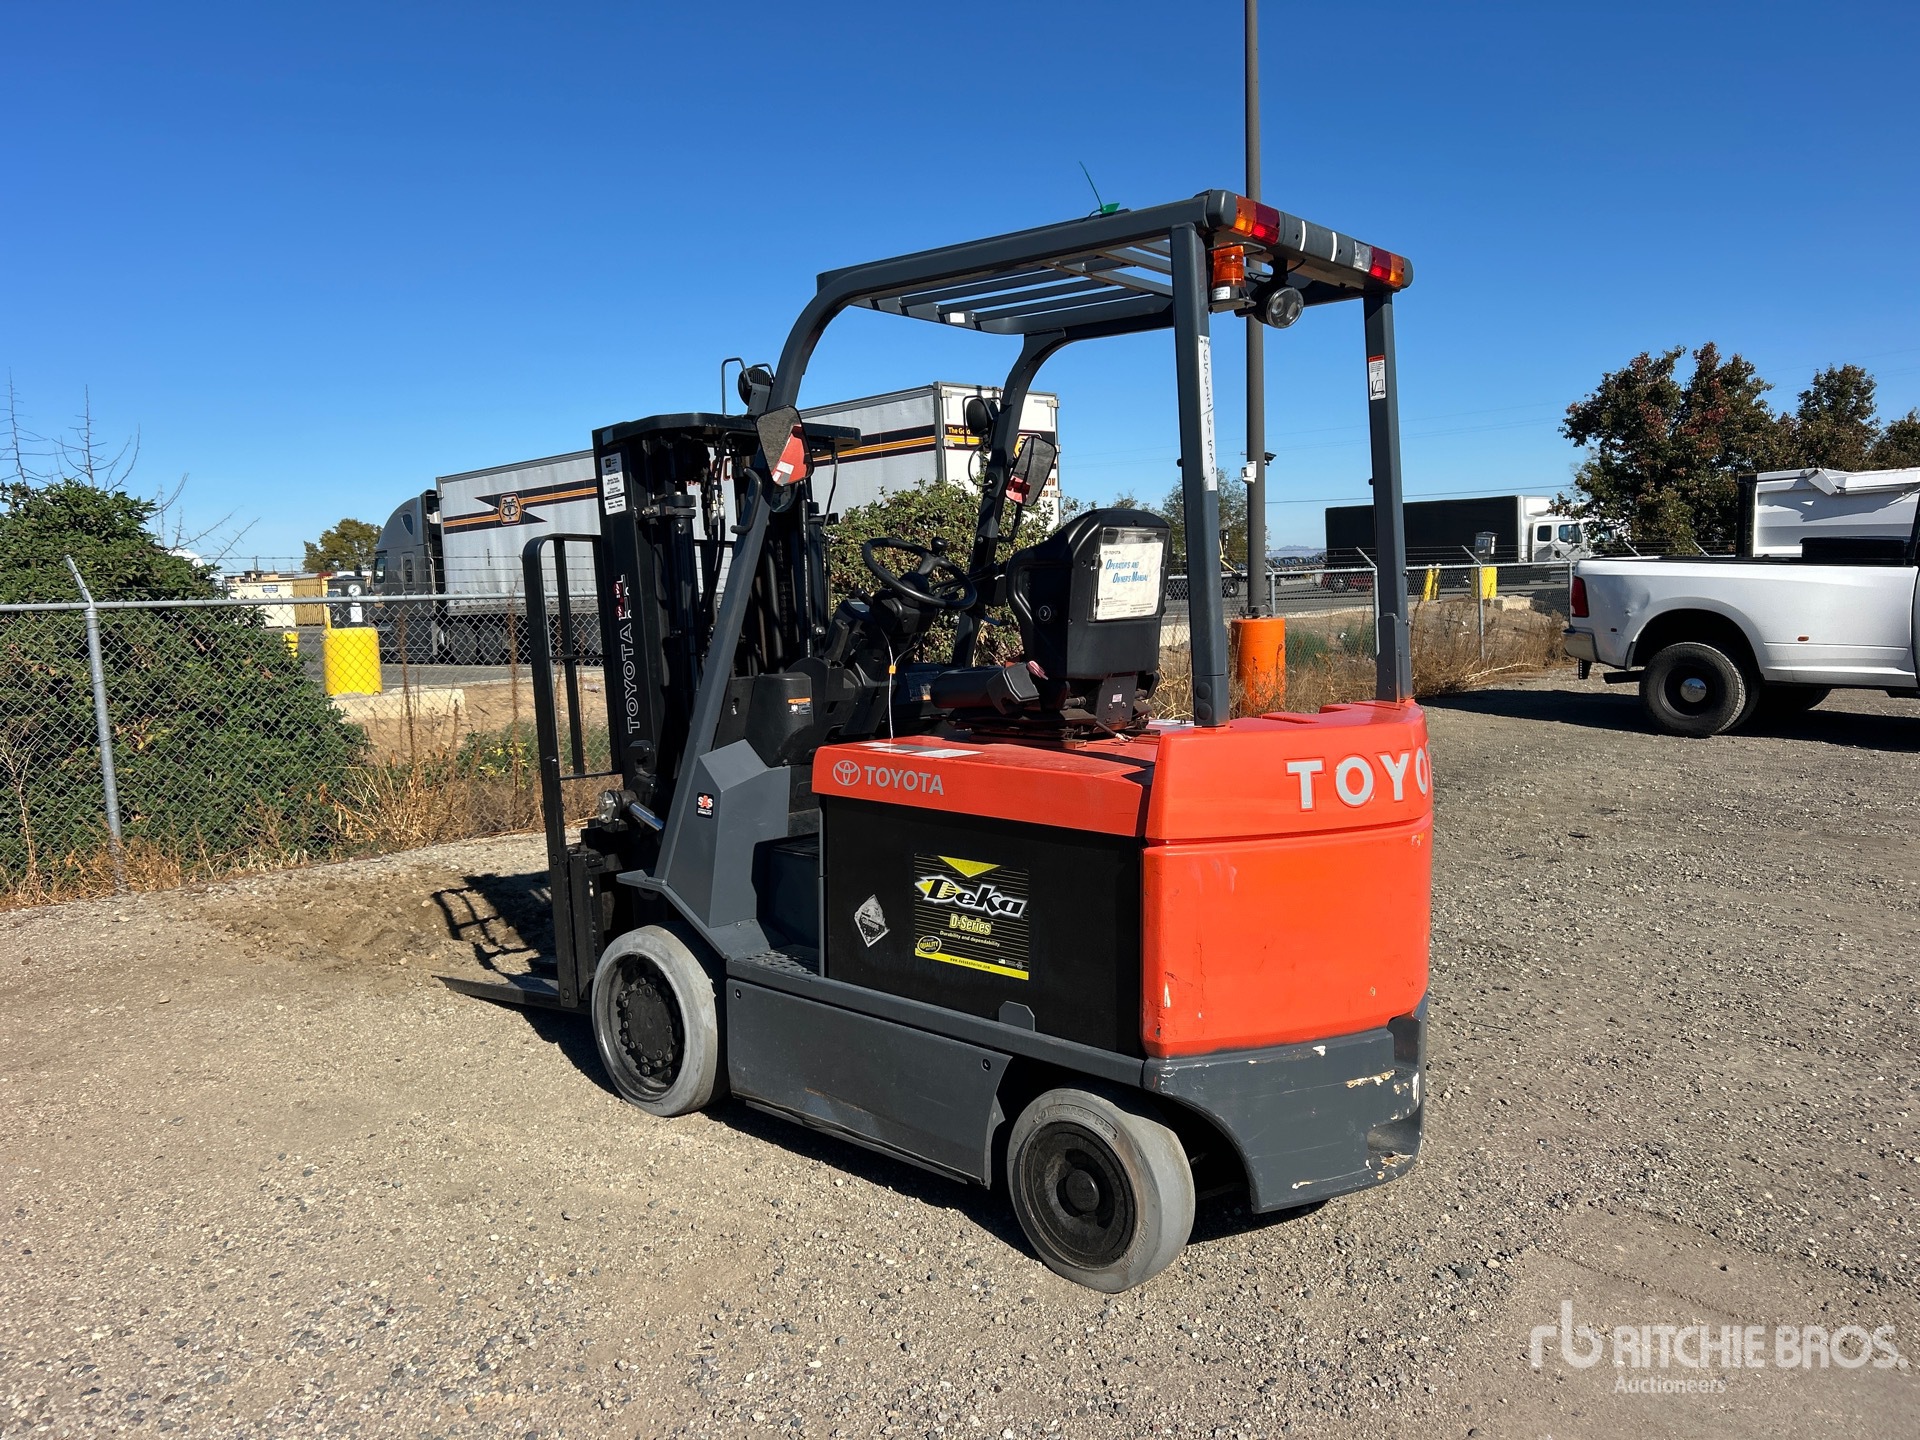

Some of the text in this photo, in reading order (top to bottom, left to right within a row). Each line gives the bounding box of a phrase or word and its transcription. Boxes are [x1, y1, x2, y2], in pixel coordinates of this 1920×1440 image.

[620, 622, 640, 734] TOYOTA
[864, 765, 944, 796] TOYOTA
[1286, 748, 1428, 809] TOYO
[915, 875, 1028, 917] Deka
[920, 940, 939, 949] QUALITY
